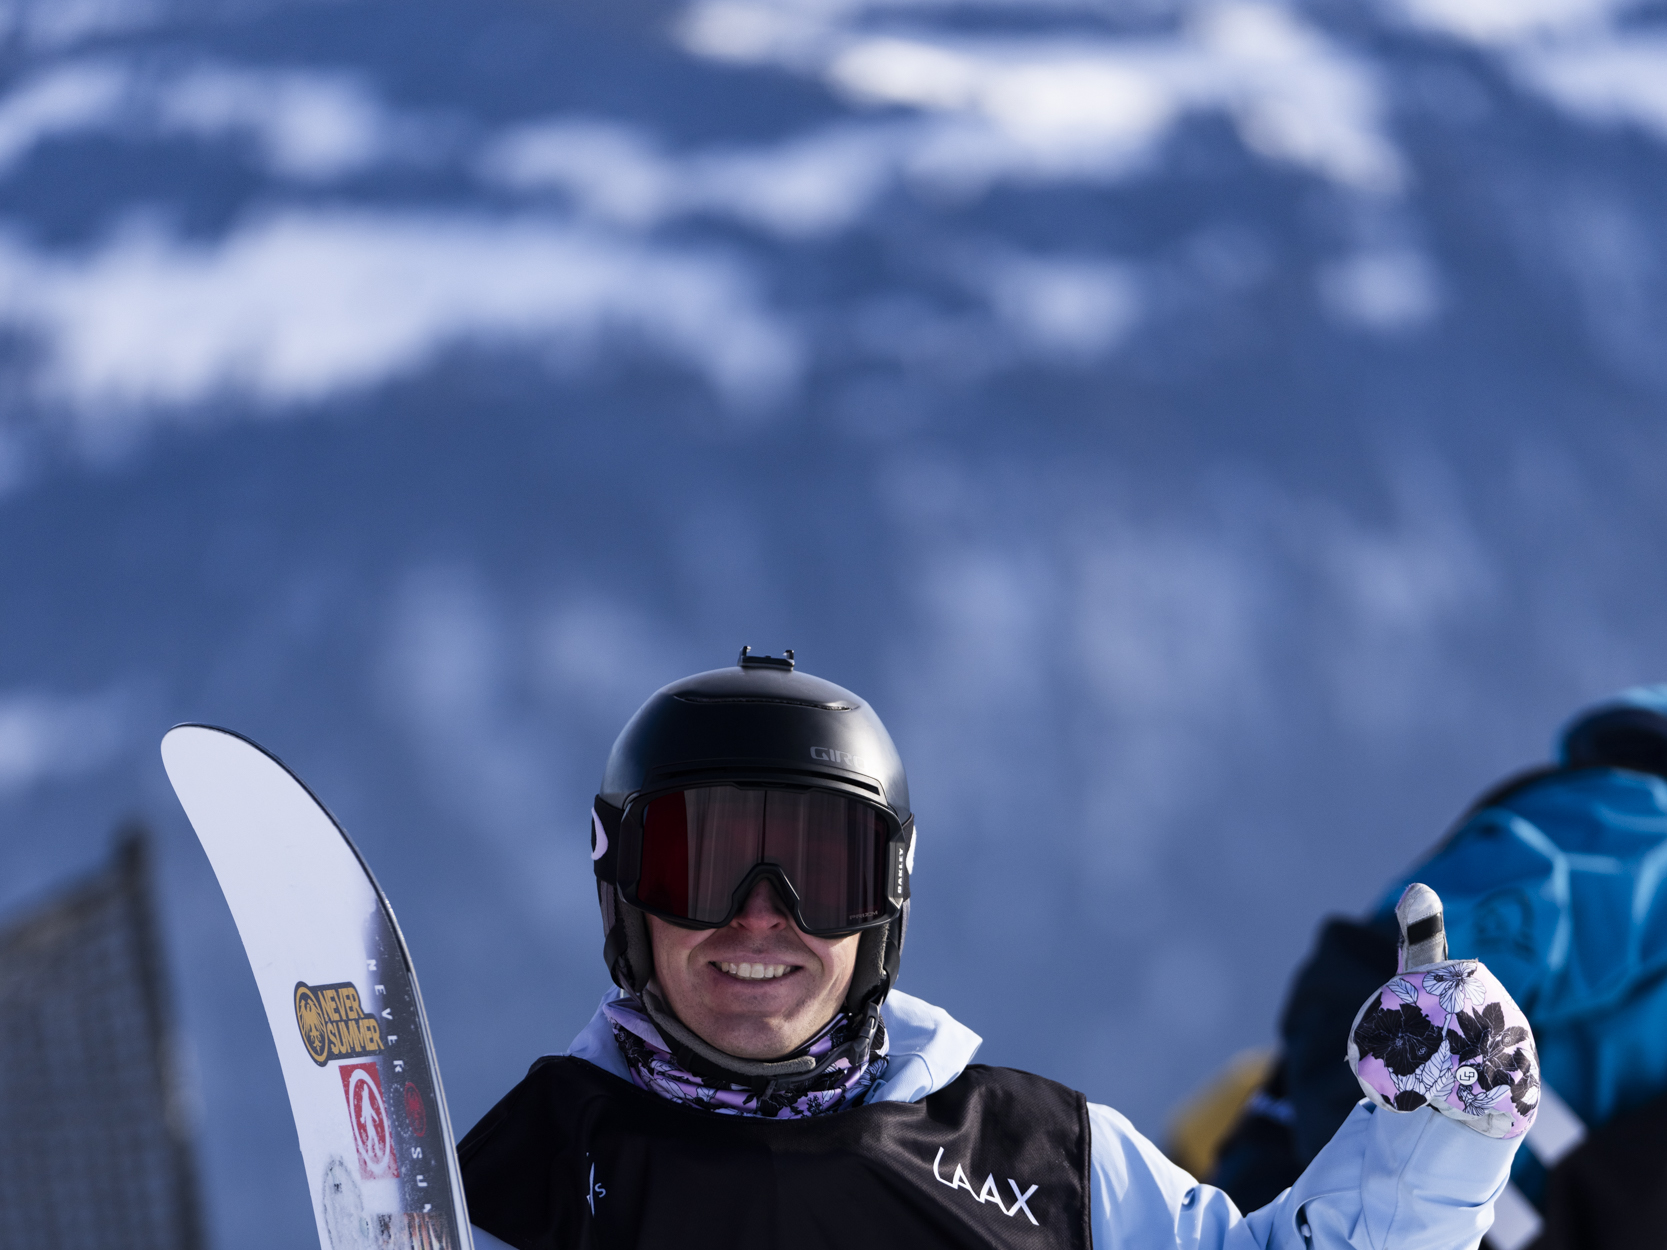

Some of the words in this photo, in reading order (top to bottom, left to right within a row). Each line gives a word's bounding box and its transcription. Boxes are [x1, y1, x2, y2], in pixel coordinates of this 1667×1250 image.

[809, 746, 868, 771] GIRO
[318, 986, 365, 1022] NEVER
[326, 1018, 384, 1055] SUMMER
[932, 1146, 1040, 1226] LAAX
